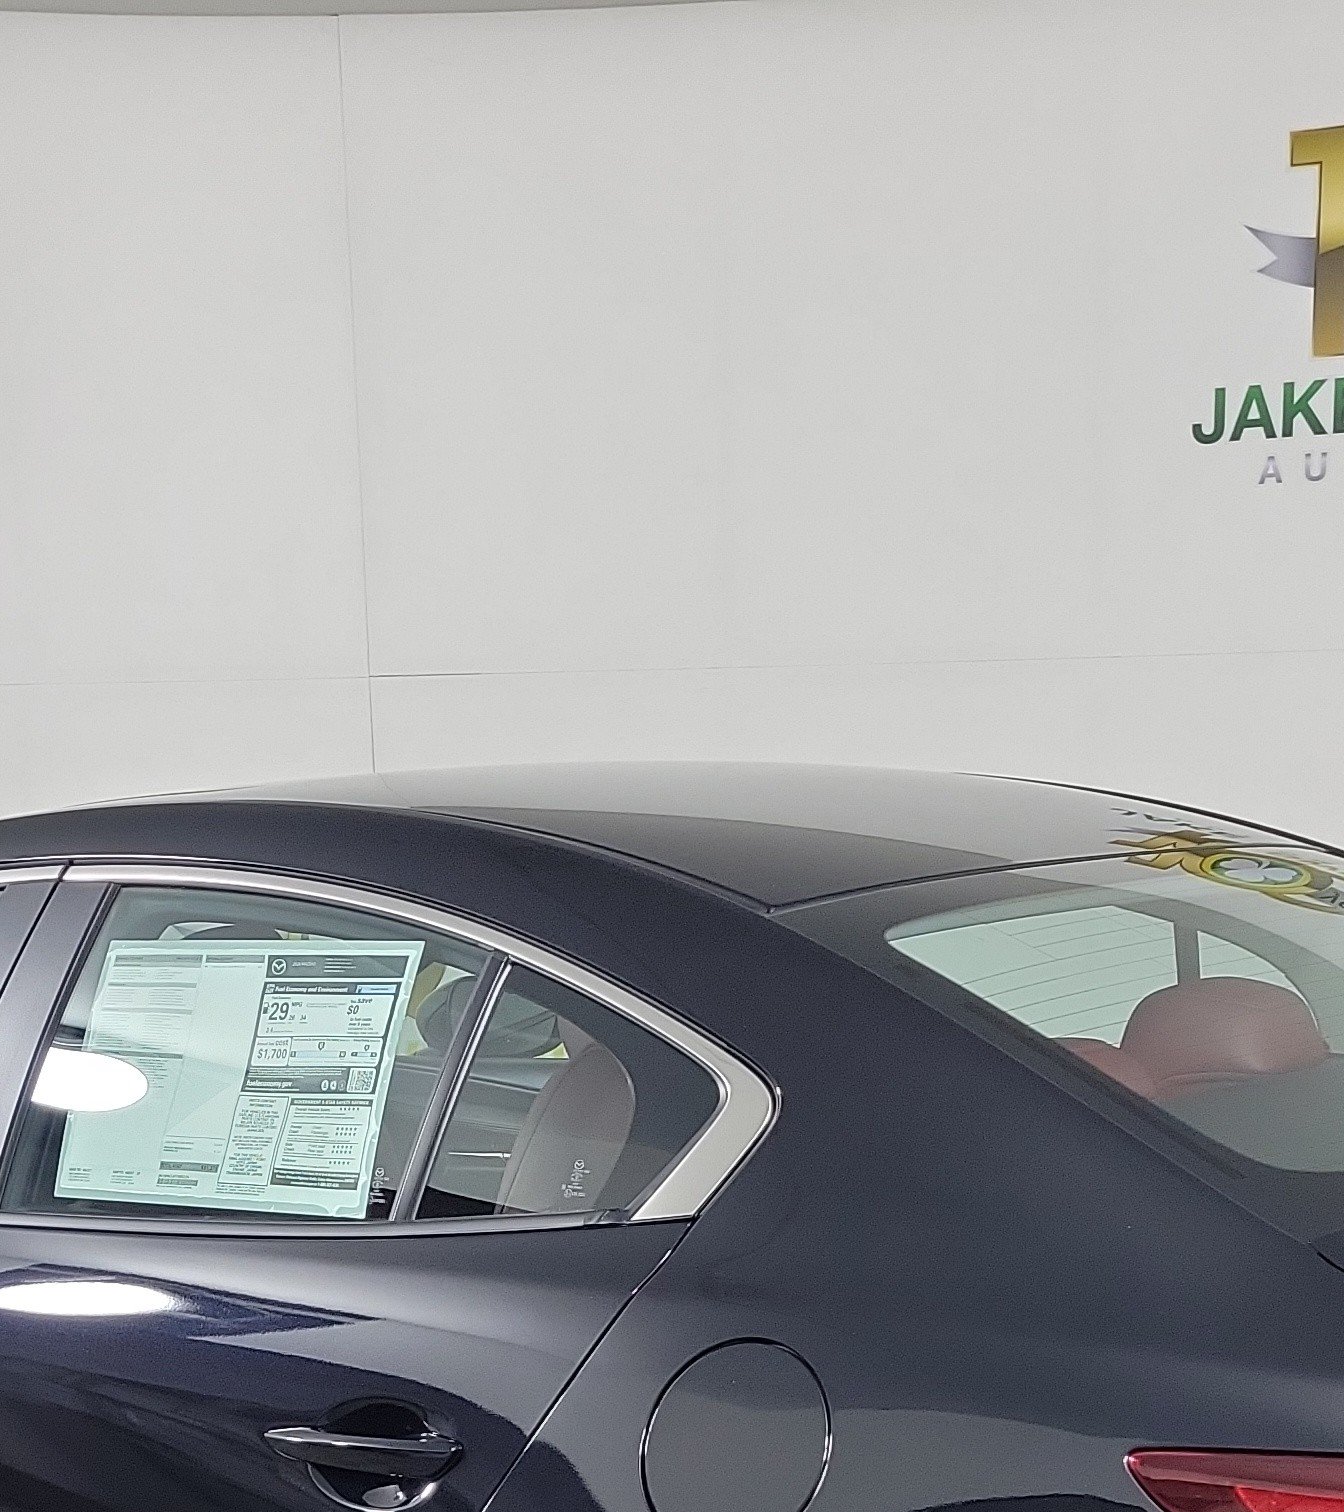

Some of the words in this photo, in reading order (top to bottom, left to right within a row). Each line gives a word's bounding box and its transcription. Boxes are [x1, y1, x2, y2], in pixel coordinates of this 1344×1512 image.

[268, 1002, 289, 1021] 29
[346, 1004, 360, 1016] $0
[256, 1048, 288, 1060] $1,700
